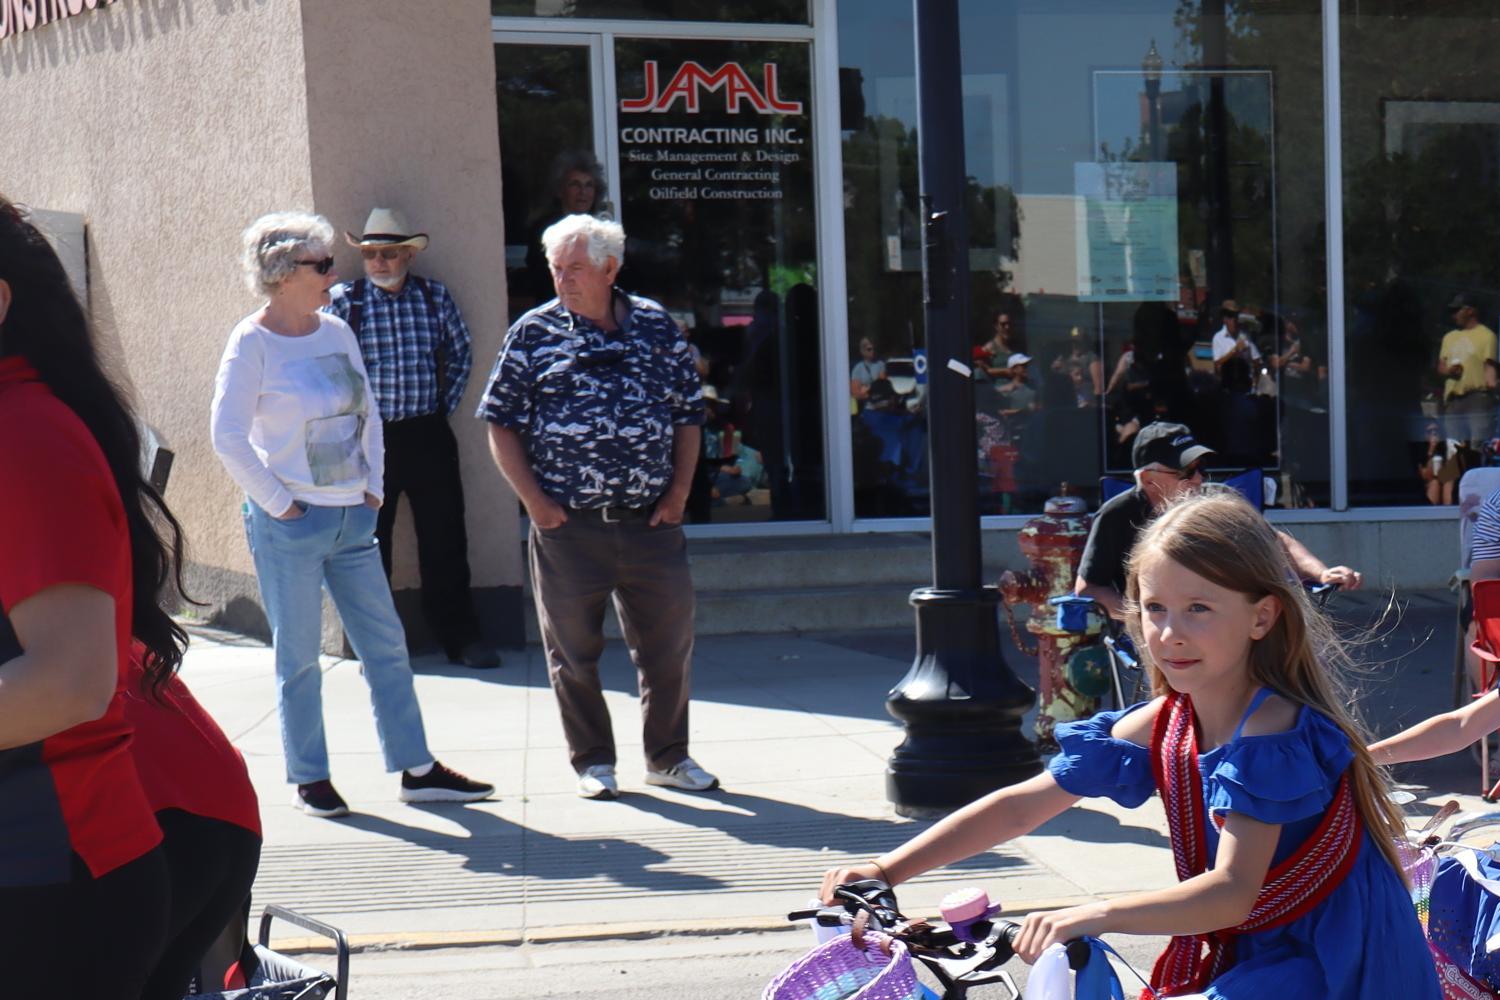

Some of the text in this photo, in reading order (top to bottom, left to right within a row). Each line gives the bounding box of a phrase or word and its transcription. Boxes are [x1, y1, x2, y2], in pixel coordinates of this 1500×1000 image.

[620, 60, 803, 114] JAMAL
[621, 128, 804, 144] CONTRACTING INC.
[628, 150, 800, 165] Site Management & Design
[651, 168, 780, 183] General Contracting
[650, 187, 783, 200] Oilfield Construction
